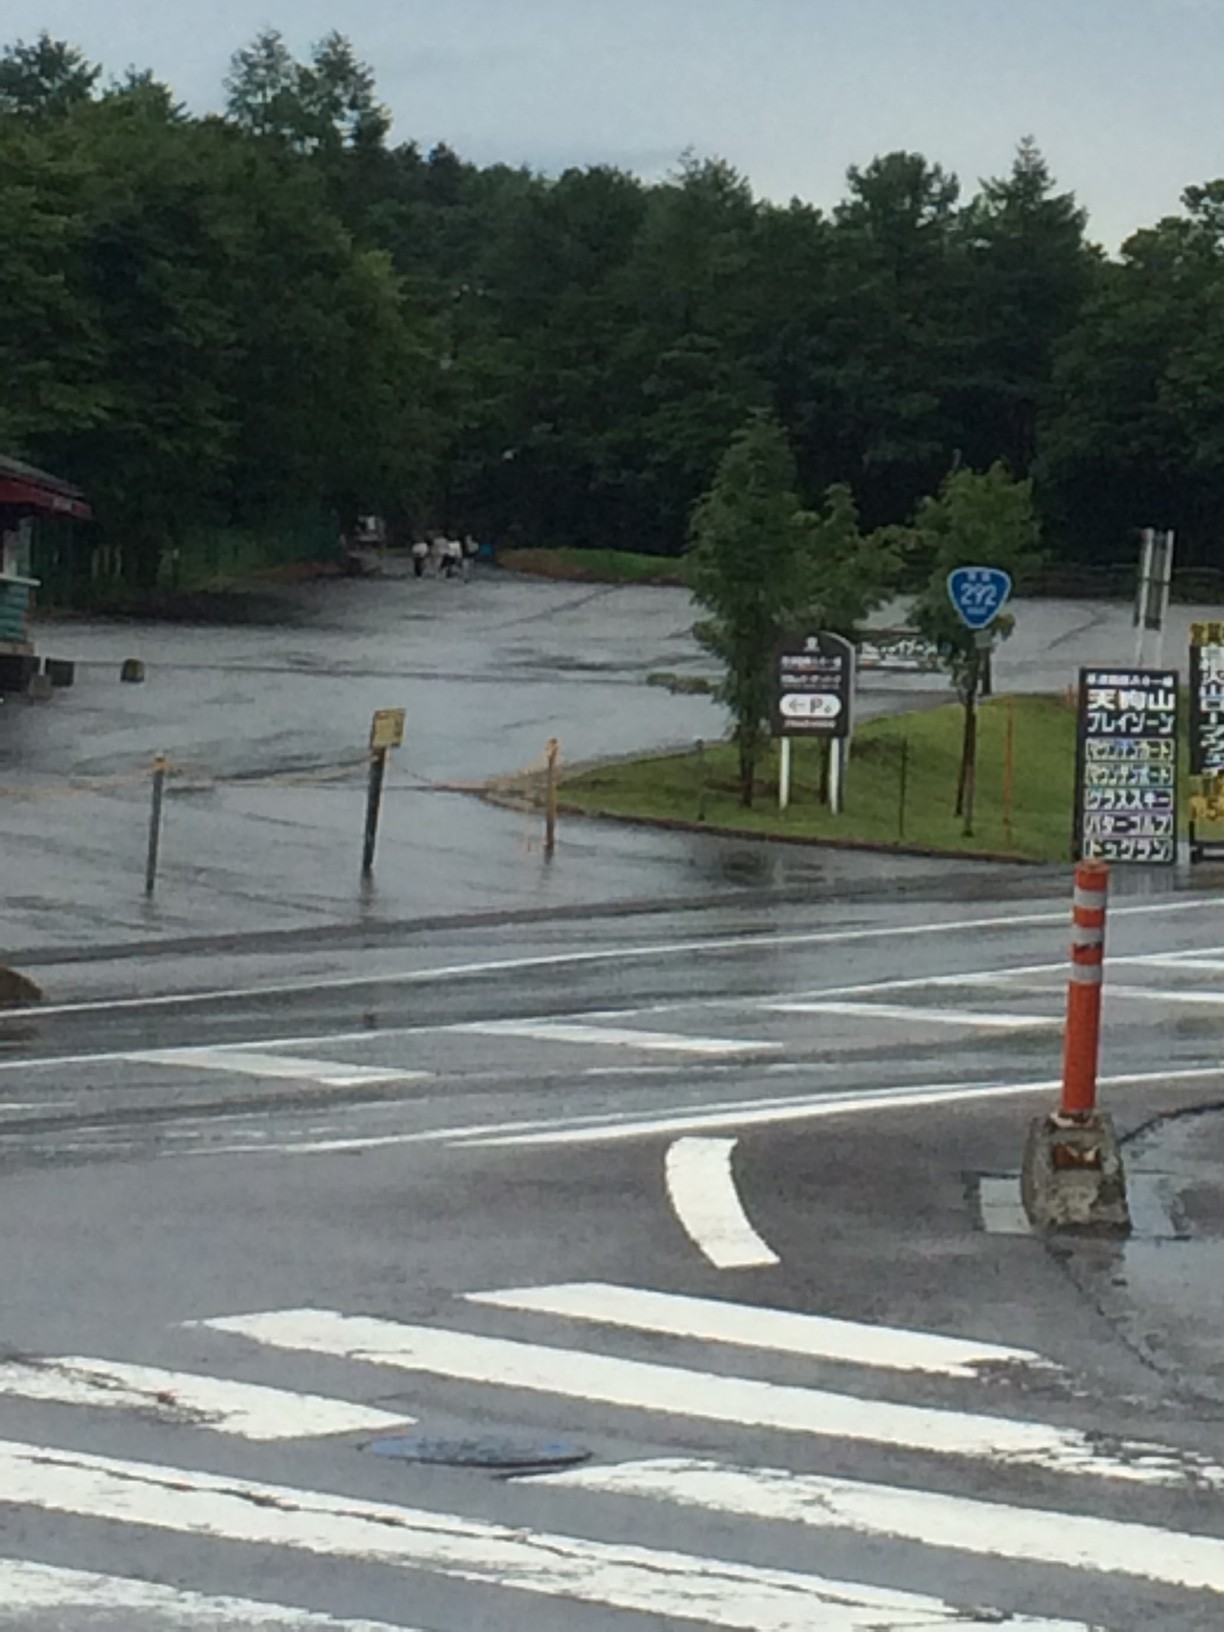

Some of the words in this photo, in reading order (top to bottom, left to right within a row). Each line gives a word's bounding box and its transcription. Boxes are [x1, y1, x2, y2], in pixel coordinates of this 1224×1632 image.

[961, 583, 997, 606] 292
[1087, 688, 1176, 711] 天狗山
[1087, 712, 1175, 733] プレイゾーン
